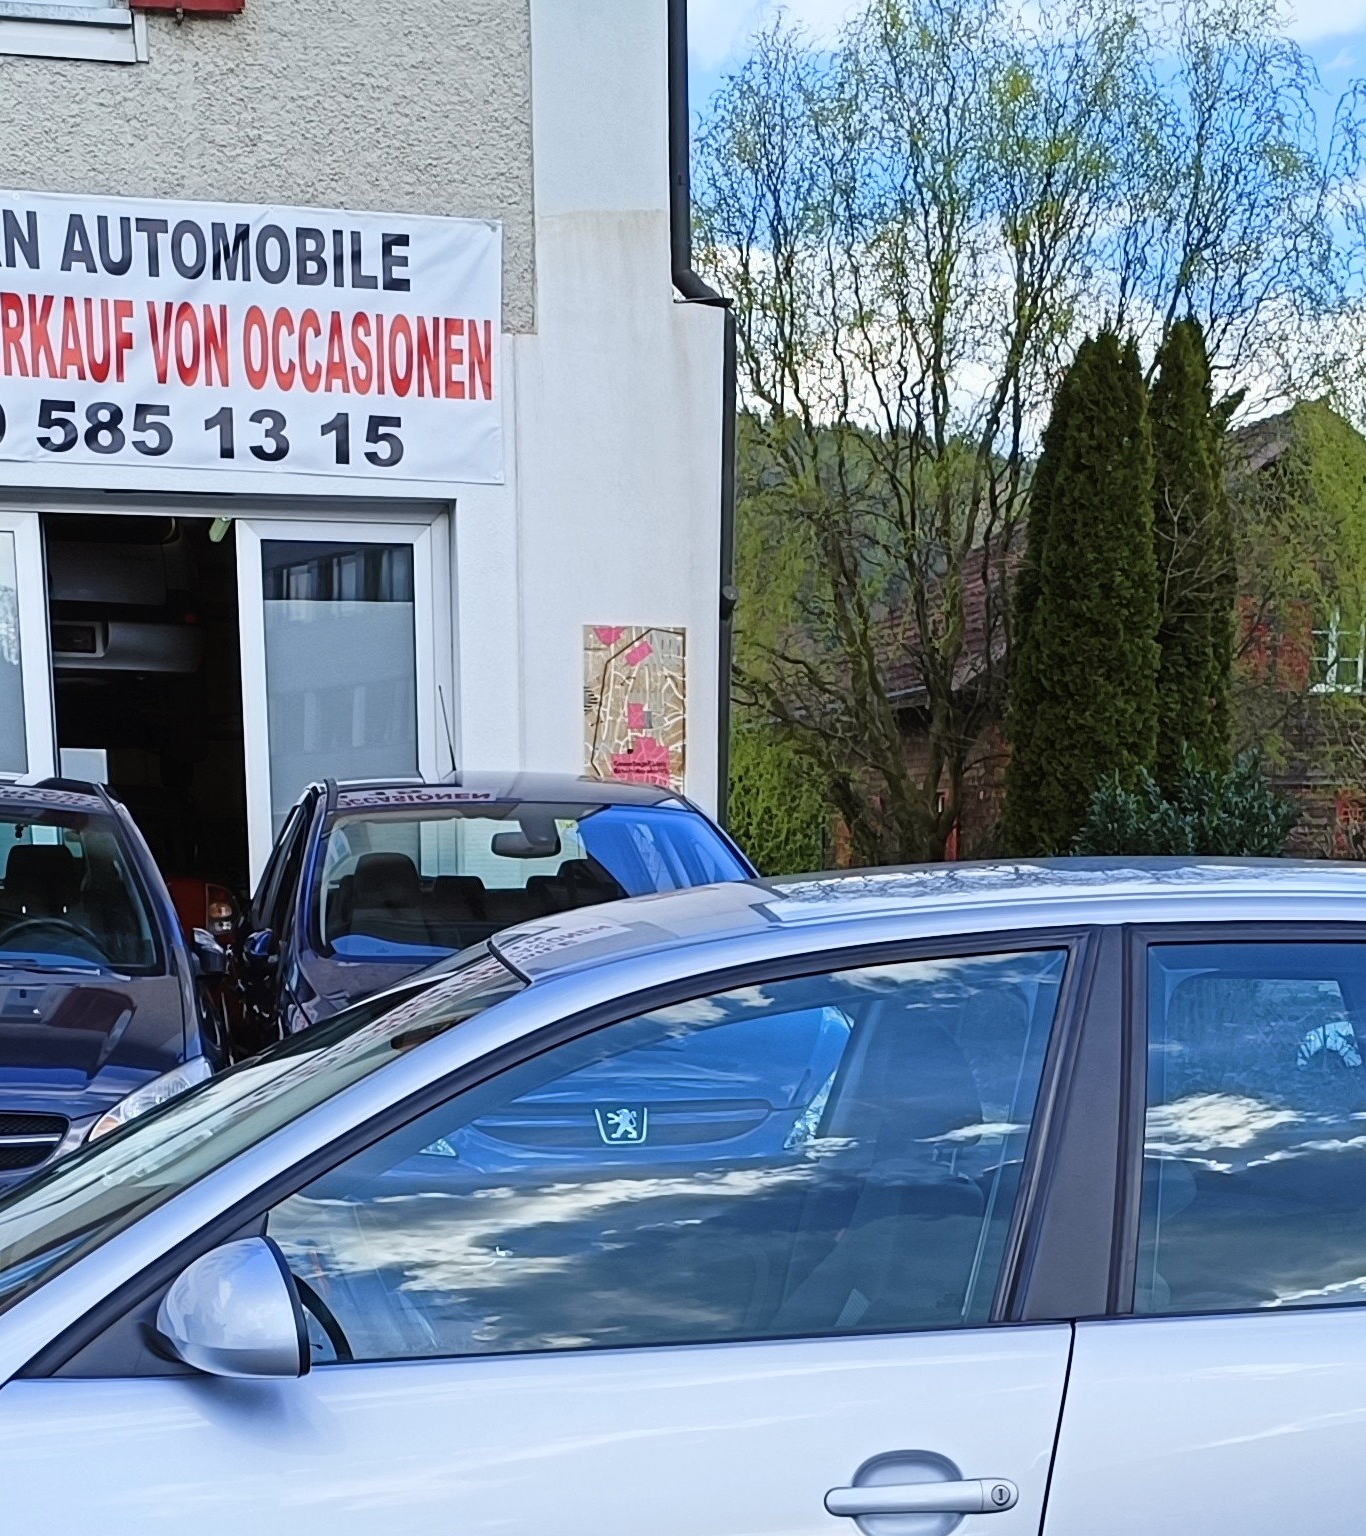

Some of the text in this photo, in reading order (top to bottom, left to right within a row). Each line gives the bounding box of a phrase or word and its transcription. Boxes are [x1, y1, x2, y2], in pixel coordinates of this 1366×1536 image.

[59, 213, 411, 293] AUTOMOBILE
[146, 300, 230, 388] VON
[243, 305, 492, 401] OCCASIONEN
[36, 398, 174, 457] 585
[204, 406, 290, 462] 13
[320, 412, 404, 468] 15
